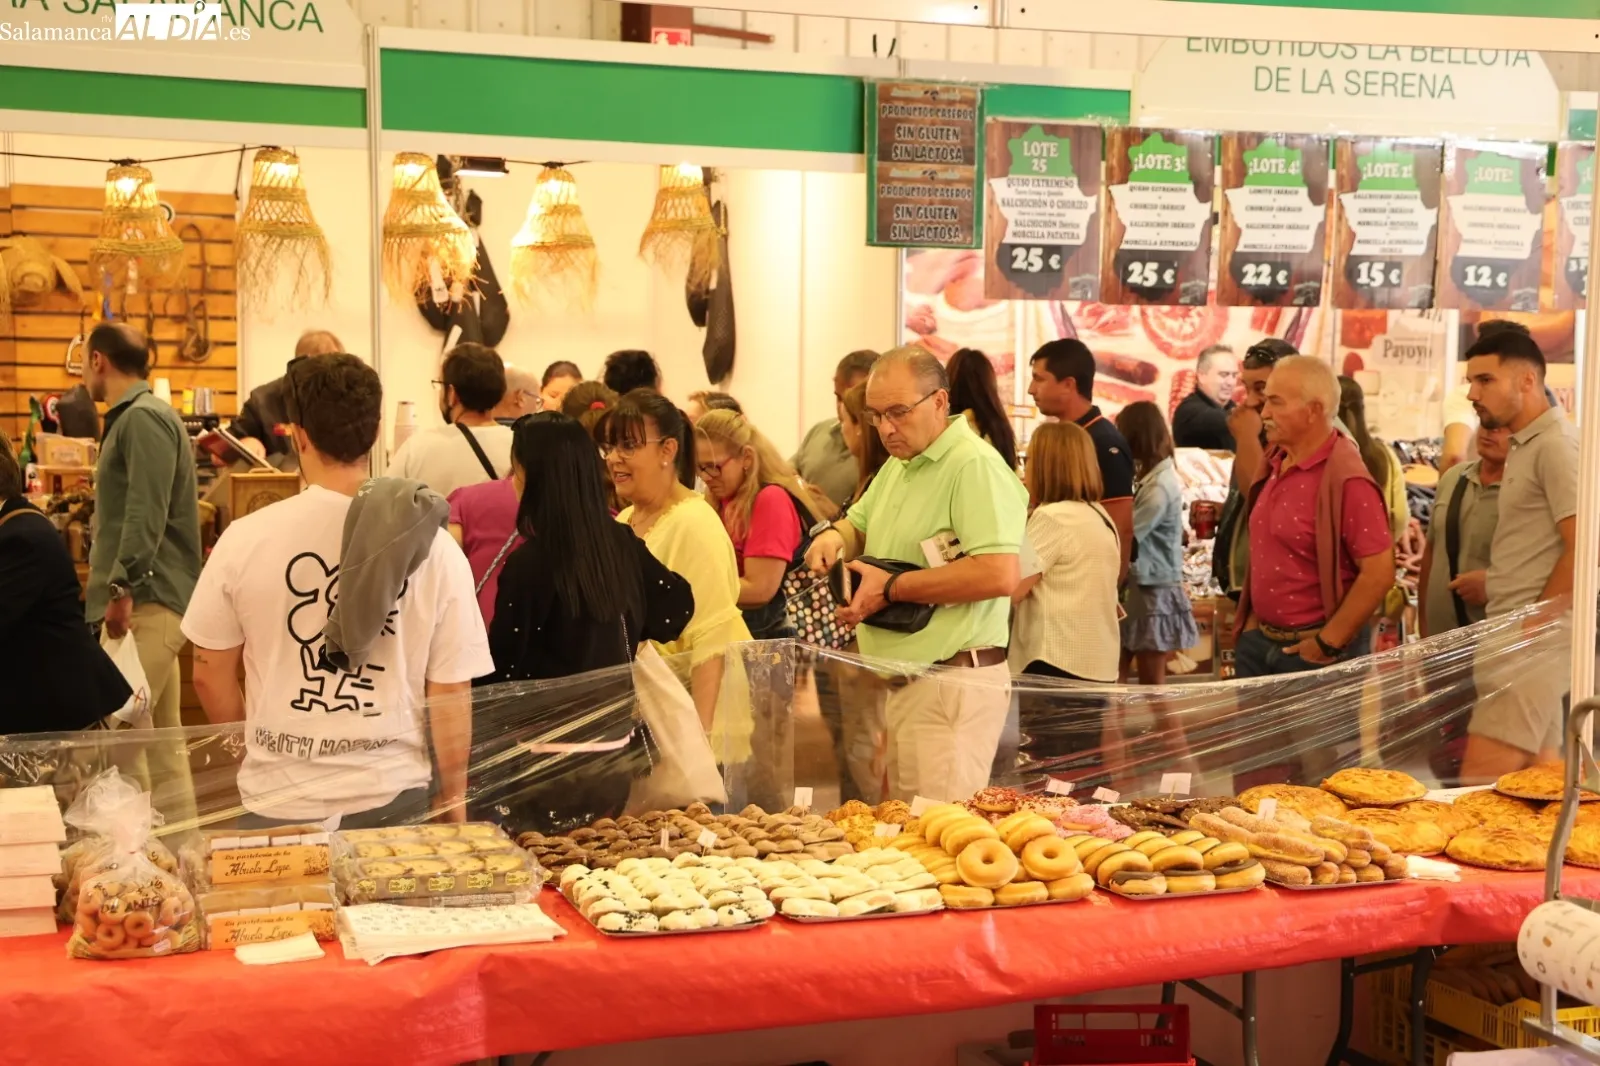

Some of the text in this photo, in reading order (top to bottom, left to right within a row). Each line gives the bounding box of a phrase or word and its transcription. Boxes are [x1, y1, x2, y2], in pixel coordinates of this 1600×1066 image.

[1186, 37, 1532, 68] EMBUTIDOS LA BELLOTA
[1254, 66, 1456, 100] DE LA SERENA
[881, 104, 974, 119] PRODUCTOS CASEROS
[896, 126, 960, 141] SIN GLUTEN
[893, 146, 963, 161] SIN LACTOSA
[1023, 141, 1059, 157] LOTE
[1031, 159, 1048, 172] 25
[1007, 178, 1030, 188] QUESO
[880, 185, 972, 200] PRODUCTOS CASEROS
[1056, 199, 1088, 209] CHORIZO
[894, 207, 958, 222] SIN GLUTEN
[892, 227, 962, 242] SIN LACTOSA
[1012, 230, 1045, 240] MORCILLA
[1011, 247, 1061, 273] 25 €
[1127, 261, 1175, 287] 25 €
[1241, 263, 1288, 286] 22 €
[1357, 261, 1400, 287] 15 €
[1464, 265, 1507, 287] 12 €
